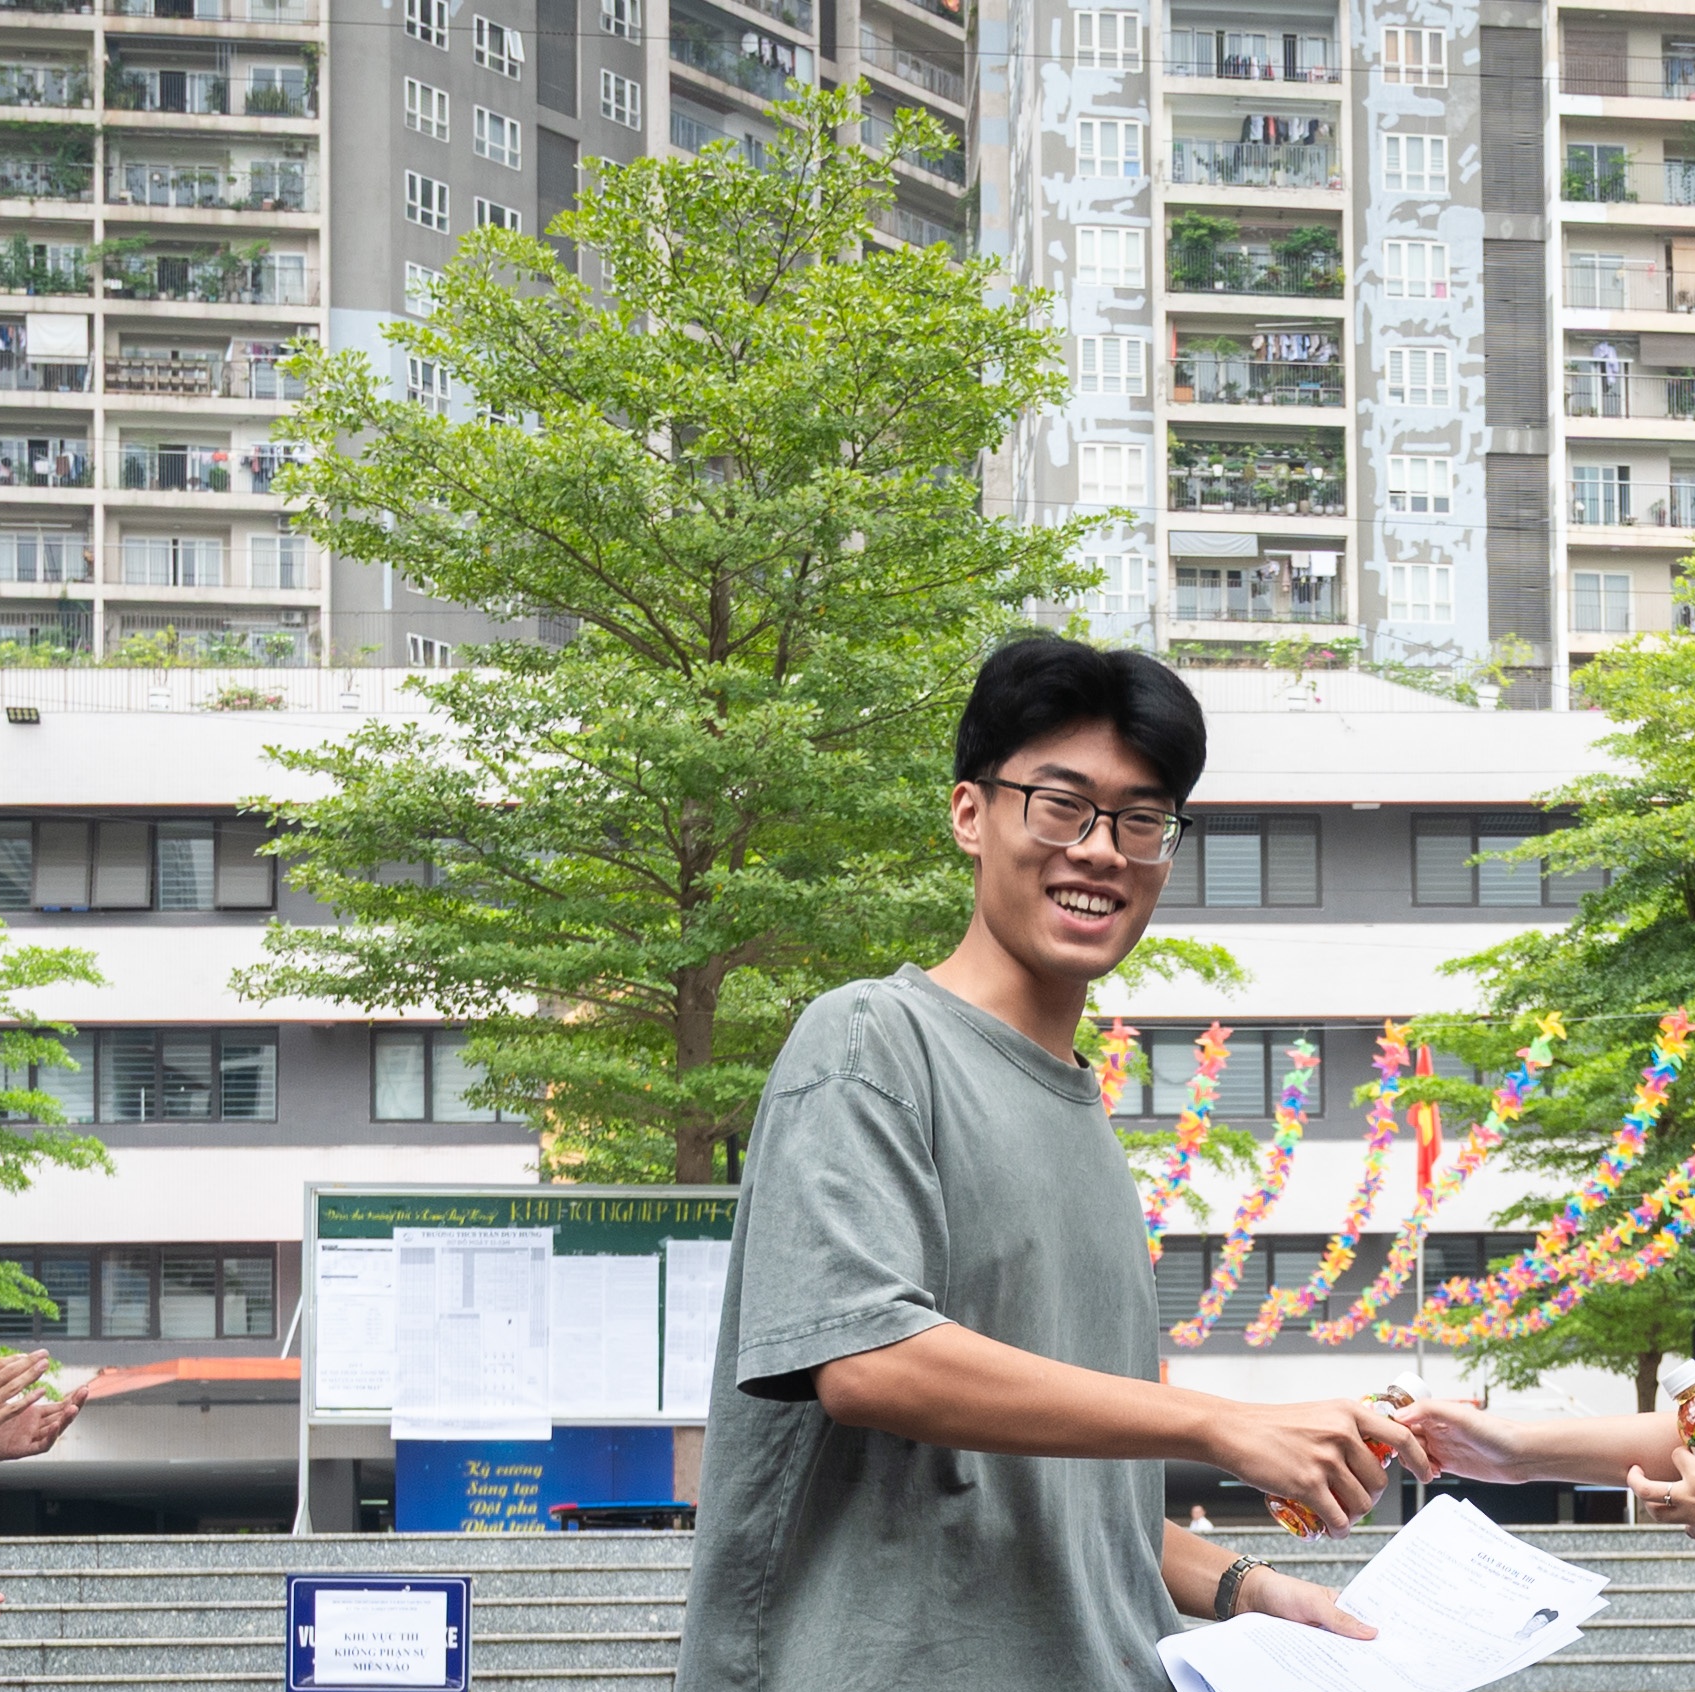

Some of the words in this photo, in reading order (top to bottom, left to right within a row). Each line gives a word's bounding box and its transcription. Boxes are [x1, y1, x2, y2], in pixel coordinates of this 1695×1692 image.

[467, 1481, 508, 1498] Sáng
[513, 1482, 539, 1499] tạo
[506, 1499, 538, 1518] phá
[344, 1632, 367, 1641] KHU
[400, 1632, 419, 1641] THI
[334, 1646, 376, 1657] KHÔNG
